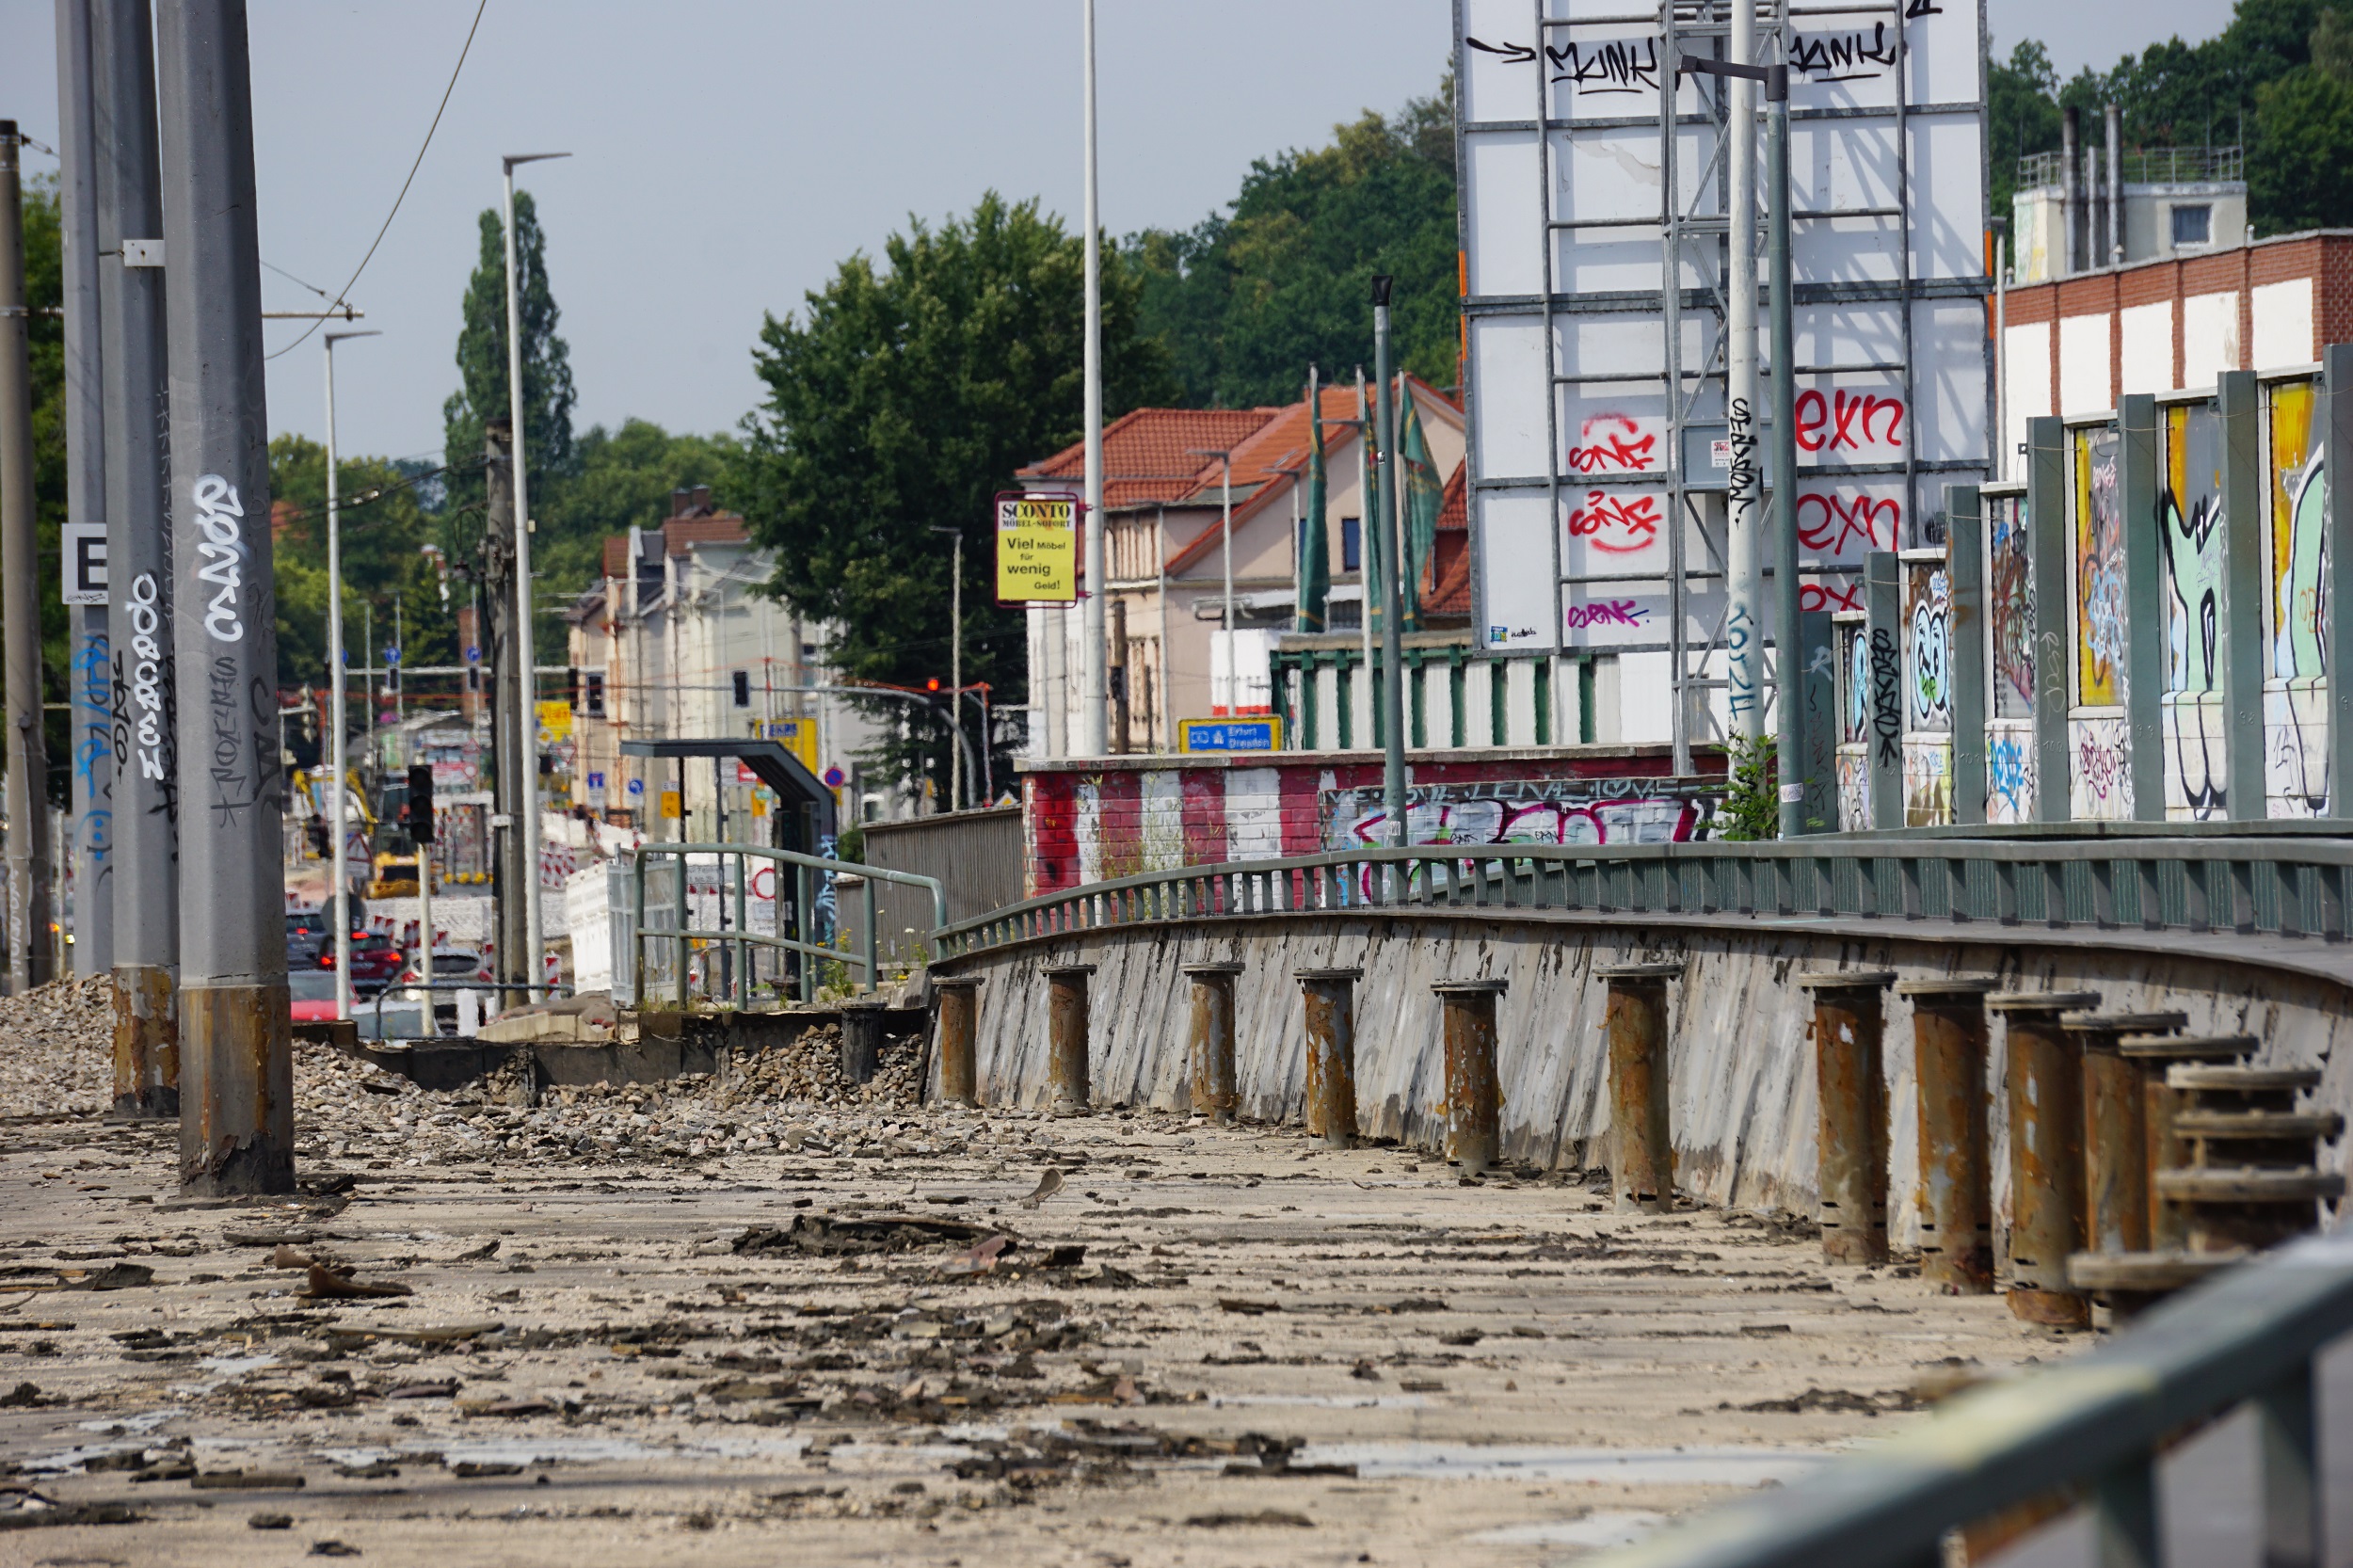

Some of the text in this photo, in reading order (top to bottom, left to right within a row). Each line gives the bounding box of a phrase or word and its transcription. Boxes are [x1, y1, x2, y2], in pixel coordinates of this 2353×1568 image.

[1002, 504, 1071, 519] SCONTO
[1002, 518, 1071, 528] MÖBEL-SOFORT
[1007, 537, 1065, 550] Viel Möbel
[1020, 552, 1033, 561] für
[1007, 563, 1050, 576] wenig
[1034, 580, 1061, 590] Geld!
